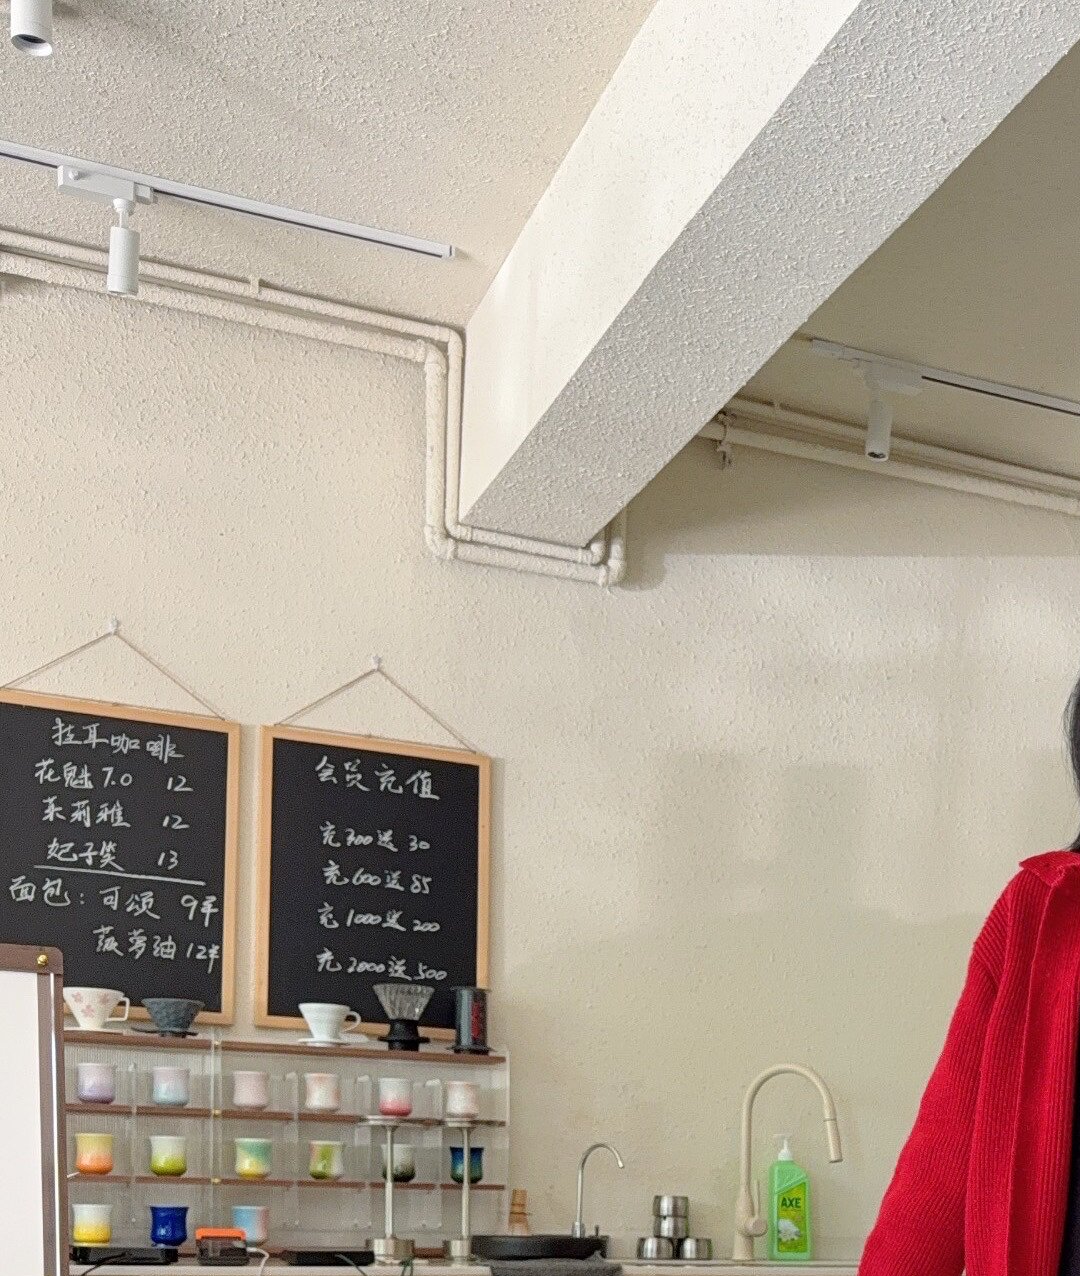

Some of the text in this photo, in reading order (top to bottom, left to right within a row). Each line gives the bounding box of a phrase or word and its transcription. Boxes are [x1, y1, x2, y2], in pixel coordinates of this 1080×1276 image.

[51, 717, 184, 764] 挂耳咖啡
[166, 775, 193, 792] 12
[162, 815, 189, 830] 12
[46, 837, 179, 871] 妃子笑 13
[93, 925, 177, 960] 菠萝油
[781, 1197, 801, 1208] AXE
